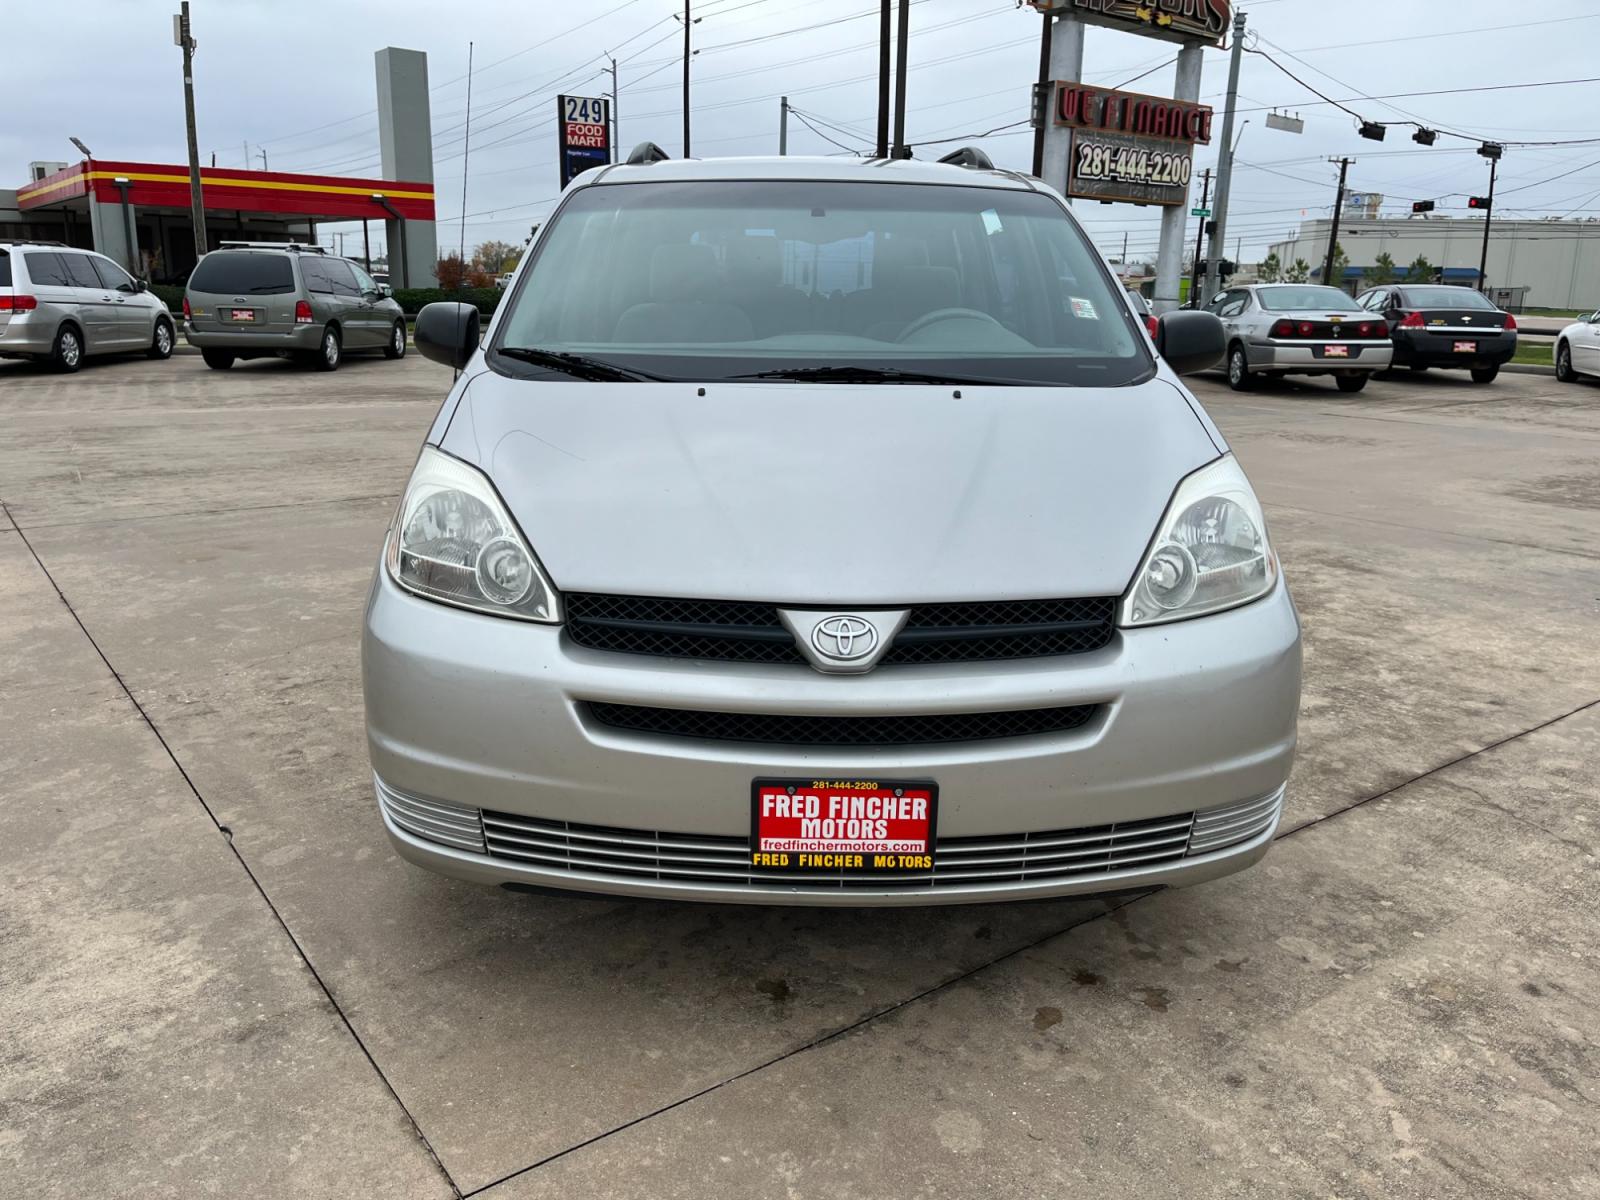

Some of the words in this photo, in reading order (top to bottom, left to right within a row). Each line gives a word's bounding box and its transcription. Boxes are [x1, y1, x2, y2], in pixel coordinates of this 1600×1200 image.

[567, 98, 602, 123] 249
[1061, 86, 1096, 125] WE
[1104, 94, 1213, 141] FINANCE
[567, 124, 603, 136] FOOD
[567, 135, 604, 148] MART
[1079, 143, 1191, 187] 281-444-2200
[812, 781, 878, 790] 281-444-2200
[762, 794, 820, 818] FRED
[829, 796, 927, 820] FINCHER
[801, 818, 888, 839] MOTORS
[763, 839, 922, 852] fredfinchermotors.com
[753, 853, 789, 866] FRED
[799, 854, 863, 868] FINCHER
